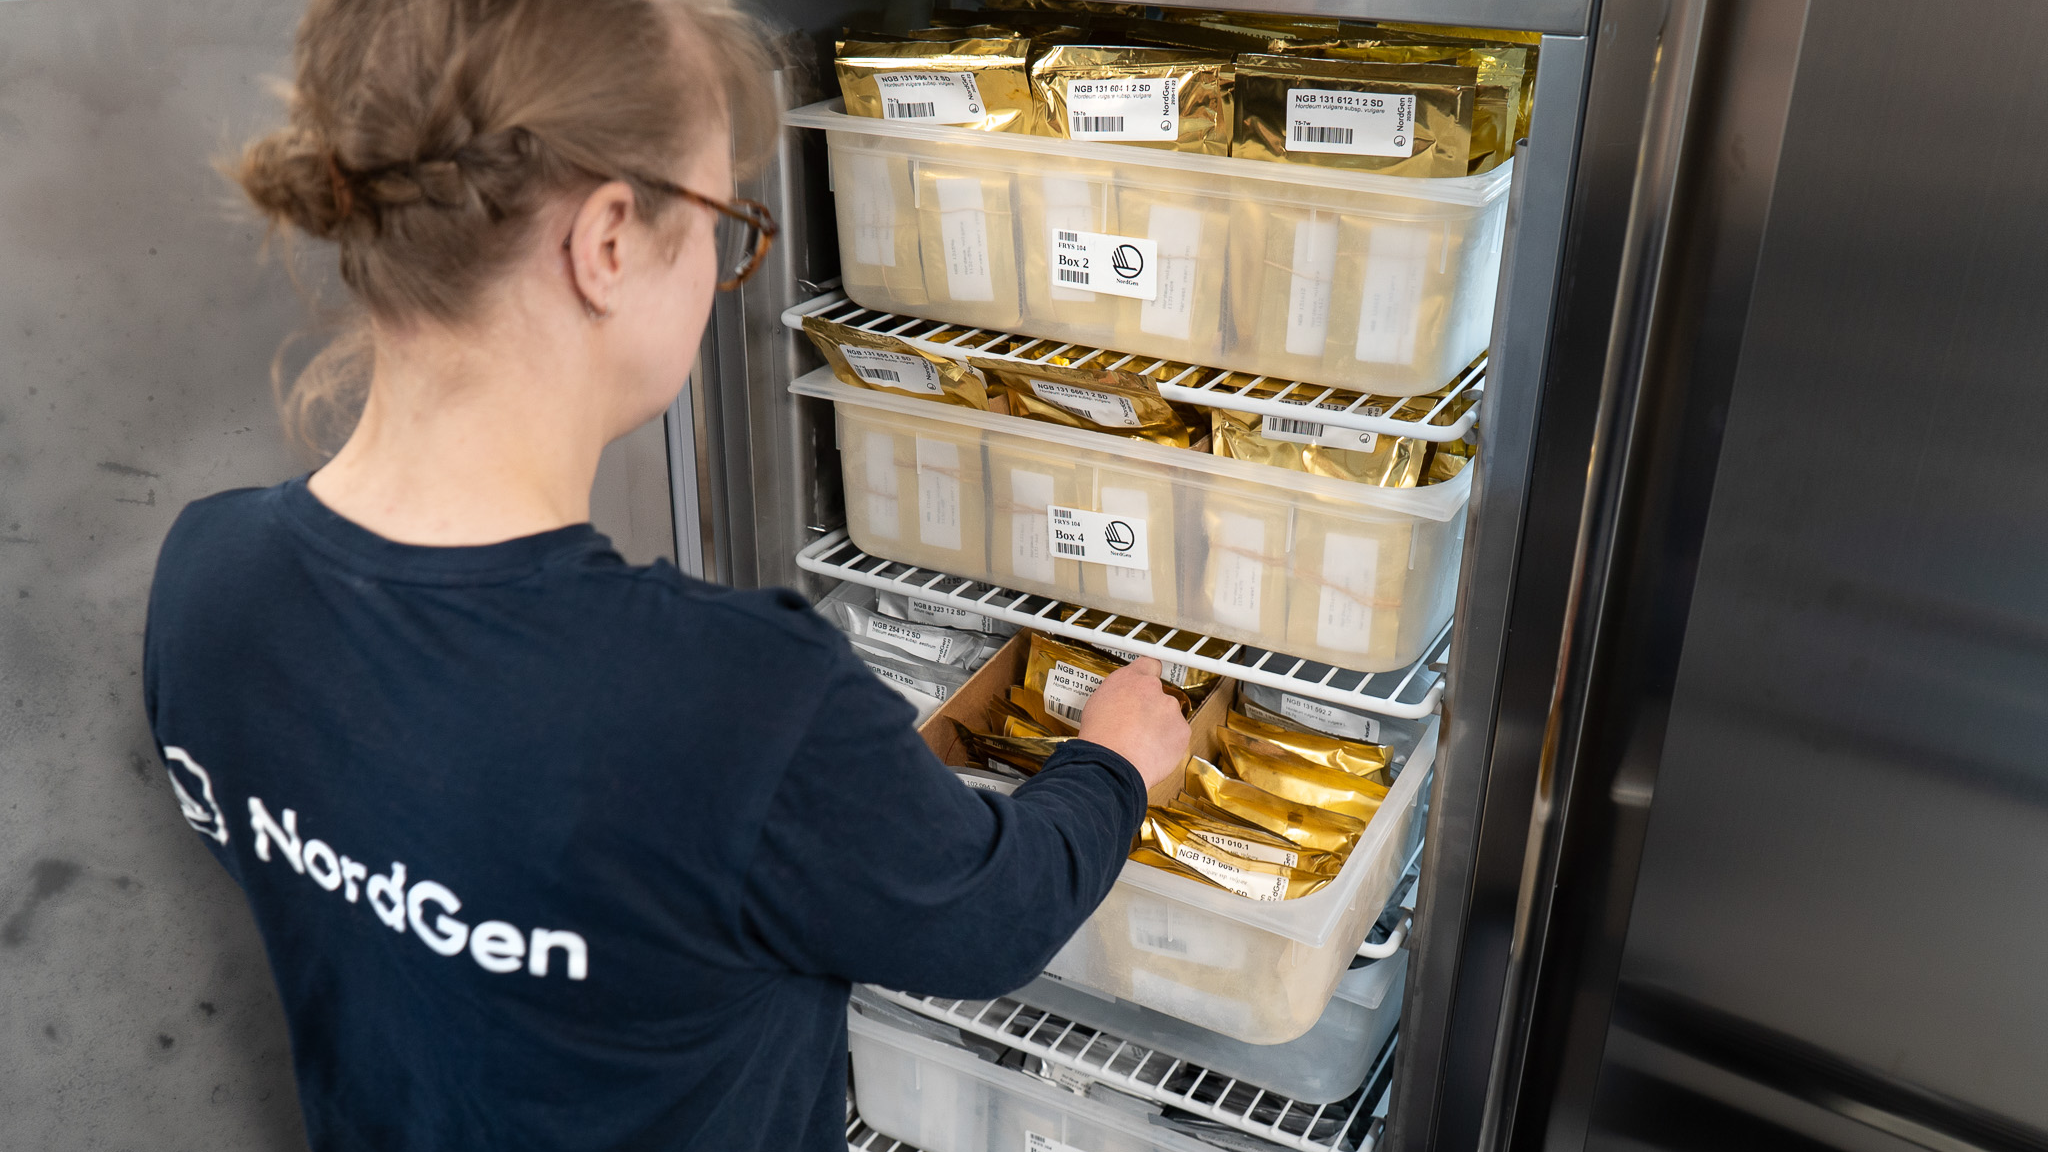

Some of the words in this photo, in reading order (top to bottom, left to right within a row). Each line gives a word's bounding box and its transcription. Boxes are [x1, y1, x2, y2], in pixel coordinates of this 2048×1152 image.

[1337, 96, 1353, 105] 612
[1396, 98, 1405, 132] NordGen
[1059, 254, 1080, 267] Box
[1082, 257, 1089, 268] 2
[1116, 278, 1139, 286] NordGen
[1055, 529, 1075, 541] Box
[1078, 533, 1084, 542] 4
[933, 605, 944, 613] 323
[872, 620, 888, 630] NGB
[889, 625, 900, 633] 254
[911, 631, 920, 639] SD
[1058, 664, 1074, 675] NGB
[1076, 671, 1088, 680] 131
[1090, 676, 1102, 685] 004
[1054, 674, 1070, 685] NGB
[1072, 681, 1083, 690] 131
[1287, 698, 1300, 706] NGB
[1211, 836, 1224, 845] 131
[1227, 840, 1249, 850] 010.1
[1179, 849, 1199, 860] NGB
[1202, 856, 1215, 866] 131
[248, 796, 588, 980] NordGen
